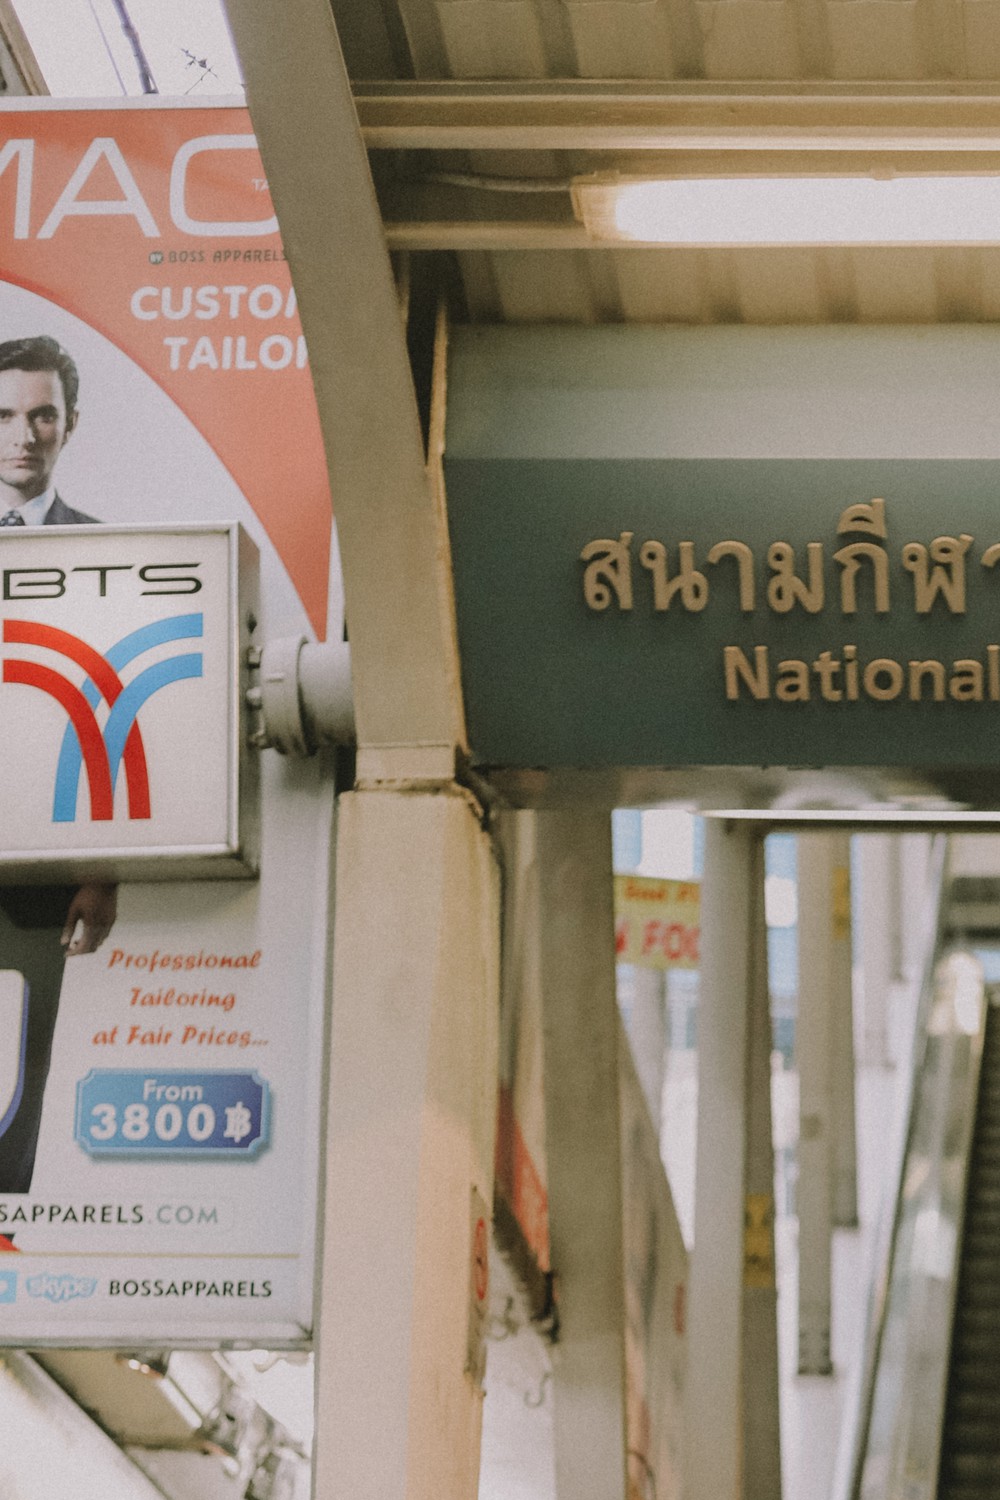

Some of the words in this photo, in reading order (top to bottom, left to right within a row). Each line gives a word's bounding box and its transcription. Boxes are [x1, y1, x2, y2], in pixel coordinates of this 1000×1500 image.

[168, 250, 205, 263] BOSS
[3, 563, 202, 600] BTS
[723, 644, 1000, 702] National
[107, 948, 262, 973] Professional
[129, 986, 236, 1012] Tailoring
[92, 1025, 118, 1045] at
[126, 1024, 172, 1045] Fair
[142, 1079, 204, 1101] From
[108, 1279, 273, 1298] BOSSAPPARELS
